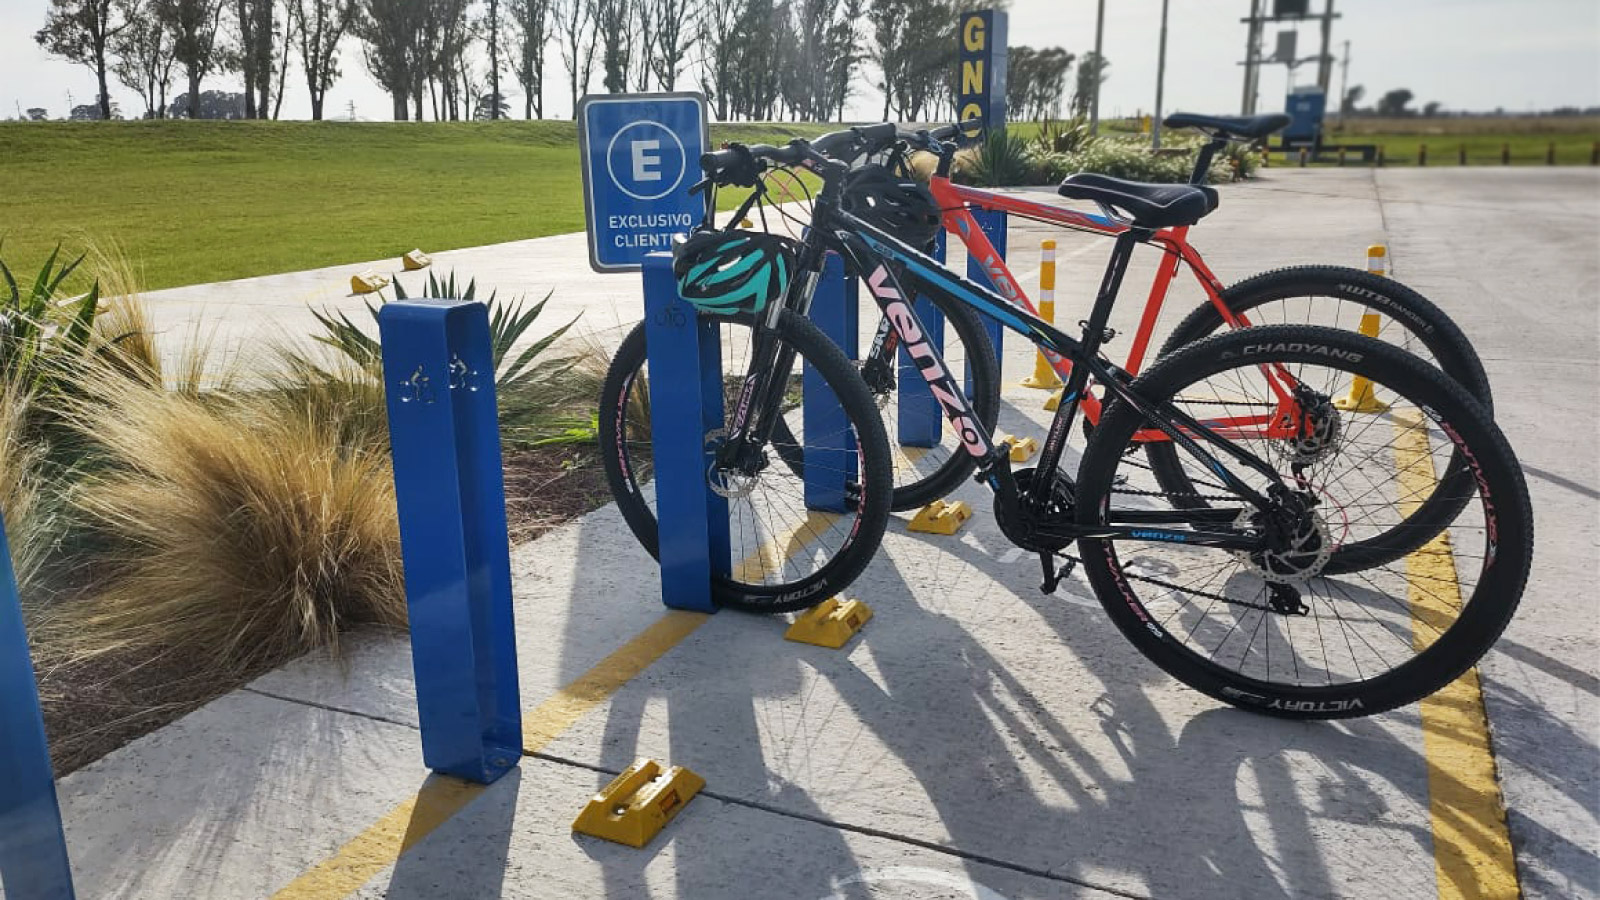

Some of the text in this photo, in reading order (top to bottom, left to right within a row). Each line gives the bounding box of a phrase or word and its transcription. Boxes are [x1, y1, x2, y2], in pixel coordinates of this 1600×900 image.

[631, 140, 661, 182] E
[609, 213, 692, 229] EXCLUSIVO
[614, 232, 688, 248] CLIENT
[1243, 343, 1364, 363] CHAOYANG
[1269, 698, 1364, 712] VICTORY
